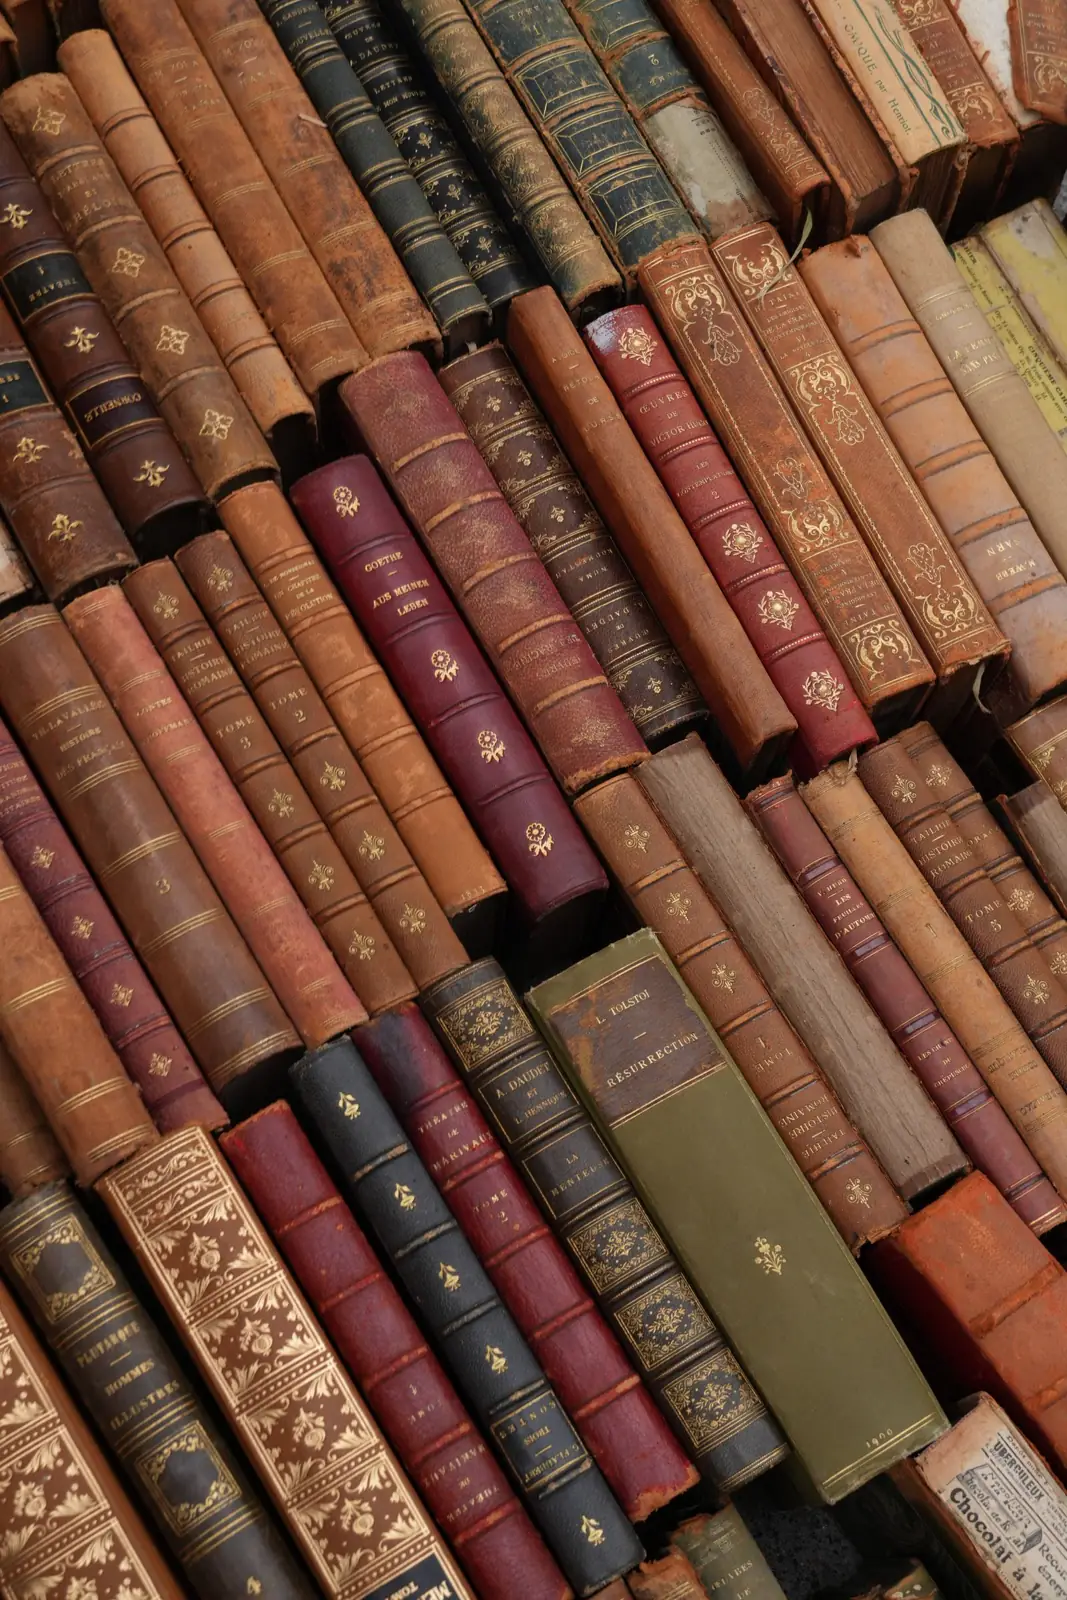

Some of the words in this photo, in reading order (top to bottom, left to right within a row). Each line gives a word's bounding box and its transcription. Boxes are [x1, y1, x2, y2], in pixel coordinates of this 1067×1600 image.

[647, 53, 659, 66] 2
[875, 79, 887, 94] par
[887, 98, 913, 135] Henriot.
[795, 334, 805, 342] VI
[563, 373, 600, 391] RETOUR
[83, 392, 142, 421] CORNEILLE
[587, 395, 599, 405] DE
[639, 389, 688, 415] ŒUVRES
[666, 410, 678, 419] DE
[650, 424, 685, 446] VICTOR
[696, 460, 709, 469] LES
[710, 489, 720, 500] 2
[363, 549, 404, 573] GOETHE
[287, 574, 322, 592] CHAPITRE
[576, 565, 607, 582] NUMA
[371, 591, 392, 608] AUS
[396, 597, 428, 616] LEBEN
[584, 606, 629, 632] DAUDET
[615, 622, 624, 630] DE
[269, 686, 308, 710] TOME
[293, 709, 307, 723] 2
[216, 715, 254, 738] TOME
[59, 726, 102, 752] HISTOIRE
[239, 735, 252, 749] 3
[56, 763, 74, 780] DES
[154, 876, 172, 895] 3
[834, 892, 851, 905] LES
[965, 898, 1002, 923] TOME
[989, 918, 1002, 933] 5
[595, 1013, 606, 1024] L.
[755, 1035, 766, 1049] 1
[606, 1031, 699, 1089] RÉSURRECTION
[754, 1047, 791, 1073] TOME
[917, 1049, 931, 1060] LES
[494, 1086, 507, 1099] A.
[508, 1061, 550, 1091] DAUDET
[526, 1088, 538, 1098] ET
[777, 1093, 829, 1127] ROMAINE
[788, 1106, 837, 1138] HISTOIRE
[433, 1131, 492, 1170] MARIVAUX
[565, 1152, 579, 1164] LA
[551, 1157, 609, 1196] MENTEUSE
[473, 1188, 508, 1213] TOME
[496, 1209, 509, 1224] 2
[76, 1320, 141, 1368] PLUTARQUE
[104, 1357, 156, 1396] HOMMES
[109, 1379, 179, 1429] ILLUSTRES
[498, 1399, 556, 1438] CONTES
[522, 1424, 551, 1445] TROIS
[865, 1427, 893, 1447] 1900
[421, 1443, 485, 1487] MARIVAUX
[522, 1448, 570, 1482] FLAUBERT
[992, 1441, 1044, 1501] UBERCULEUX
[457, 1477, 470, 1488] DE
[947, 1485, 1014, 1564] Chocolat
[991, 1510, 1002, 1523] de
[383, 1580, 419, 1600] TOM
